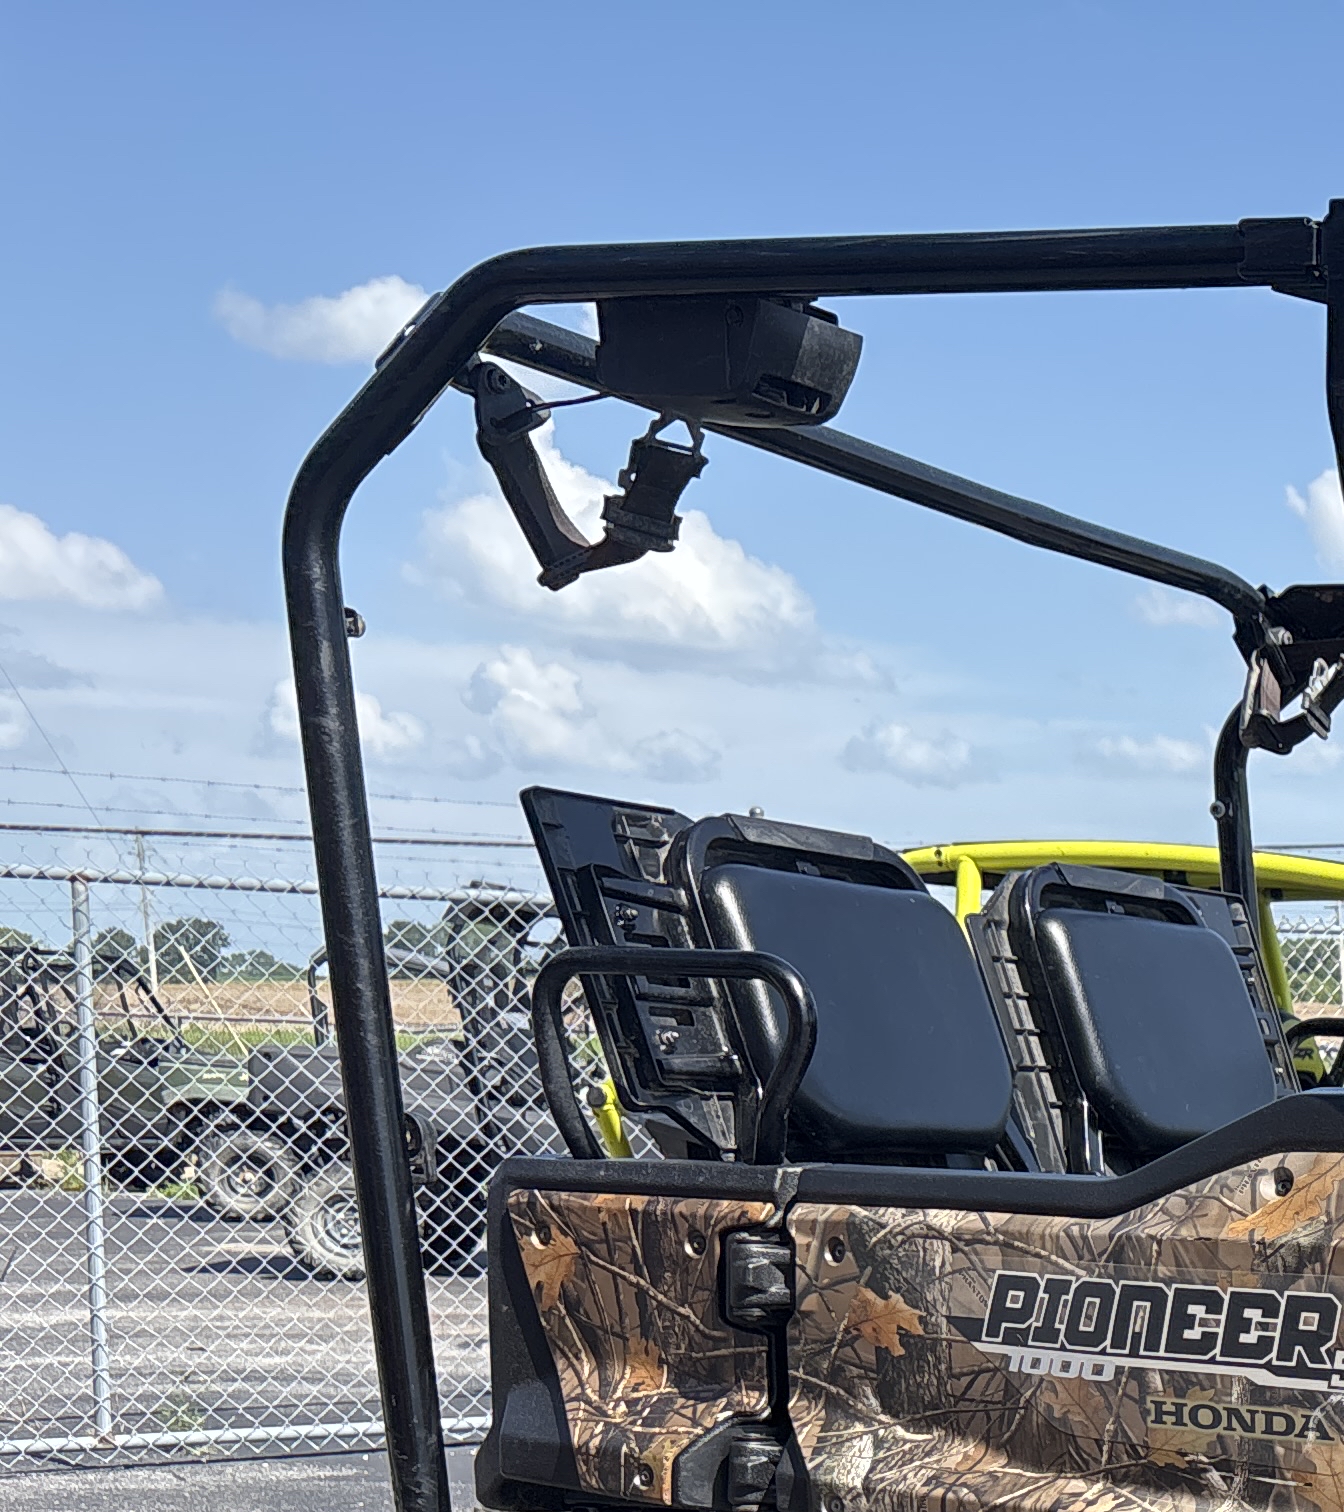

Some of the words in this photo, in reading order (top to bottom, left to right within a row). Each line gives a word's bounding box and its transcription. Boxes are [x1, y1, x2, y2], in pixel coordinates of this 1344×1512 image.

[983, 1271, 1343, 1370] PIONEER
[1004, 1351, 1116, 1383] 1000
[1147, 1399, 1337, 1443] HONDA
